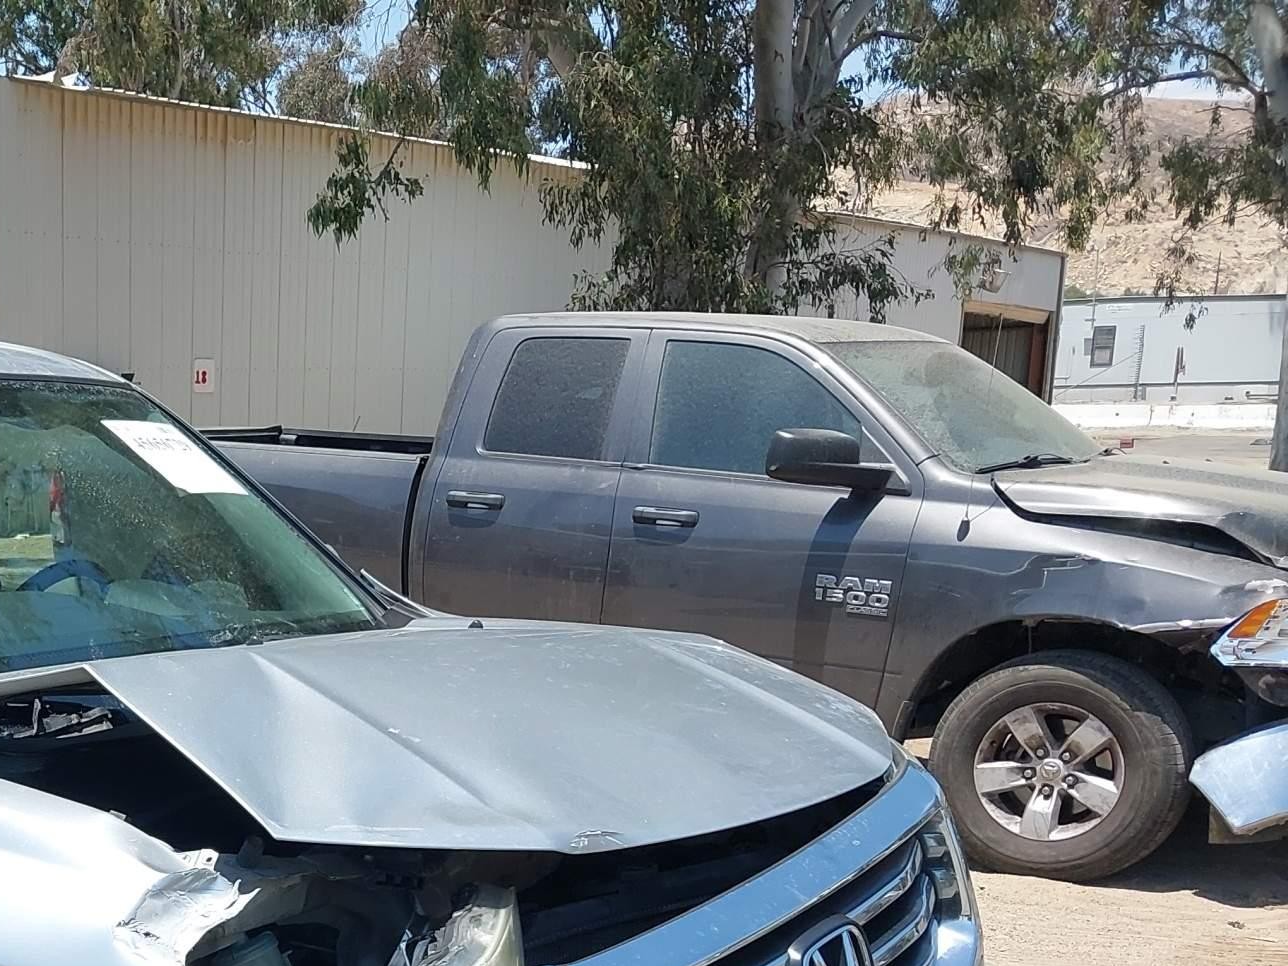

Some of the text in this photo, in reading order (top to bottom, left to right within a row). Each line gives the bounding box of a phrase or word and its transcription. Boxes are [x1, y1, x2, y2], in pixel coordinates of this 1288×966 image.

[194, 369, 208, 385] 18
[815, 573, 892, 593] RAM
[815, 588, 889, 608] 1500
